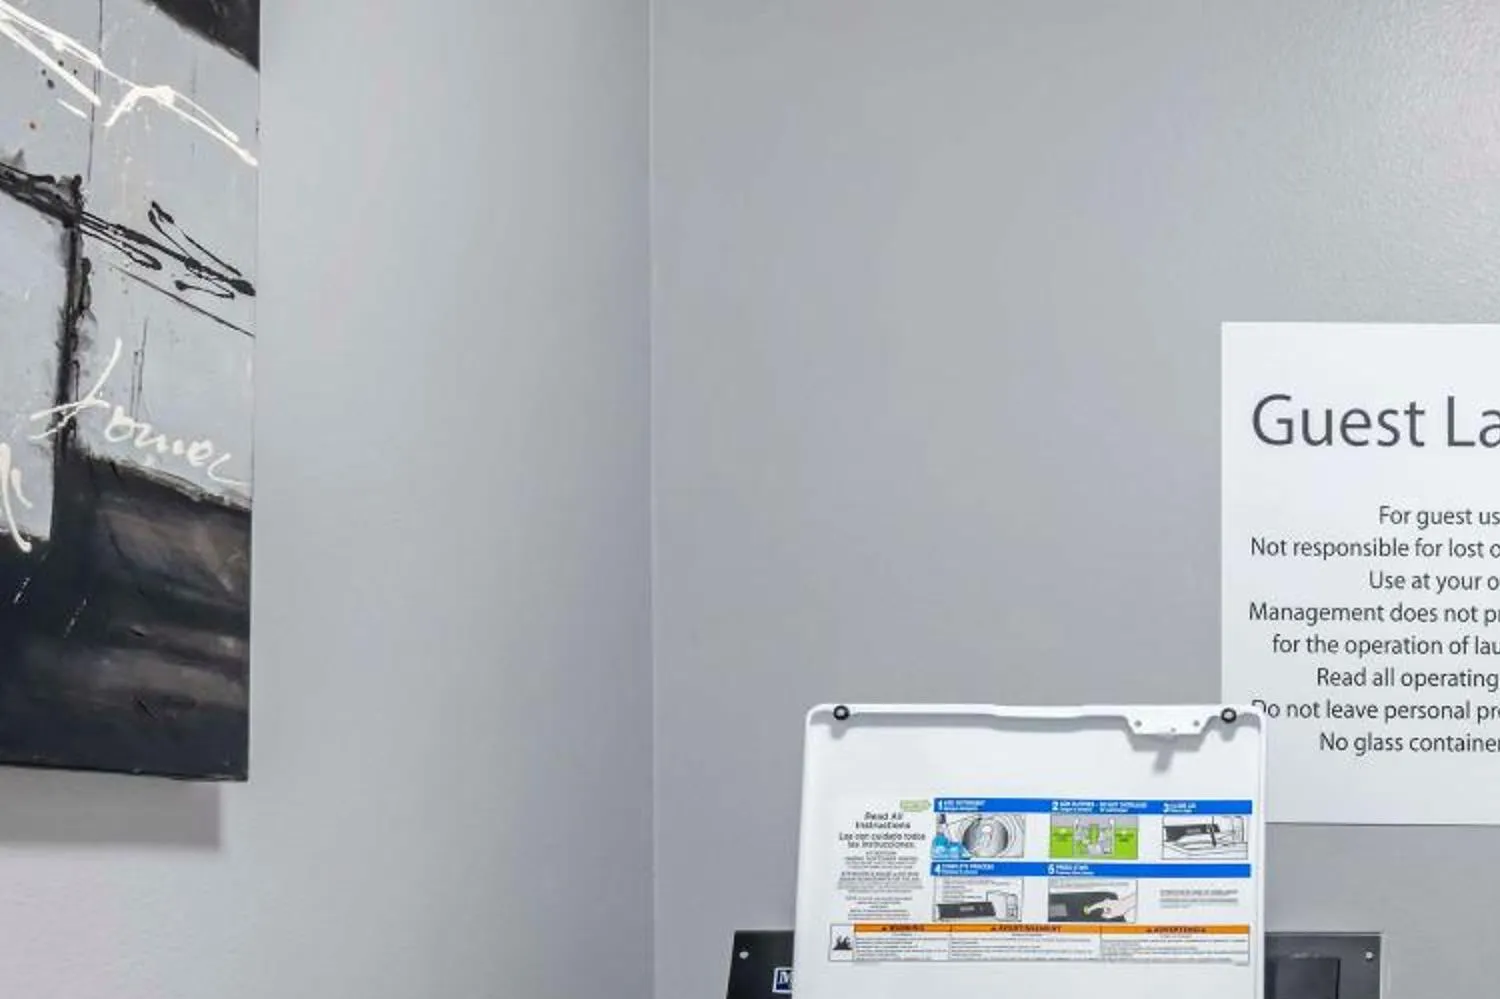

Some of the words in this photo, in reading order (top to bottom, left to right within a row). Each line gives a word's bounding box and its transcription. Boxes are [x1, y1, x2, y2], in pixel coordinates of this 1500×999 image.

[1251, 393, 1426, 449] Guest
[1378, 504, 1412, 525] For
[1415, 508, 1473, 531] guest
[1250, 536, 1288, 557] Not
[1292, 536, 1410, 561] responsible
[1414, 536, 1444, 558] for
[1448, 537, 1485, 559] lost
[1369, 569, 1407, 591] Use
[1410, 572, 1431, 591] at
[1435, 575, 1483, 596] your
[1249, 601, 1385, 627] Management
[1388, 601, 1439, 624] does
[1443, 605, 1479, 624] not
[1271, 632, 1301, 654] for
[1305, 633, 1340, 655] the
[1343, 635, 1444, 660] operation
[1447, 634, 1471, 656] of
[1316, 666, 1368, 687] Read
[1371, 666, 1395, 687] all
[1399, 668, 1499, 693] operating
[1286, 701, 1321, 720] not
[1325, 698, 1379, 720] leave
[1383, 699, 1471, 725] personal
[1319, 731, 1349, 752] No
[1353, 731, 1405, 758] glass
